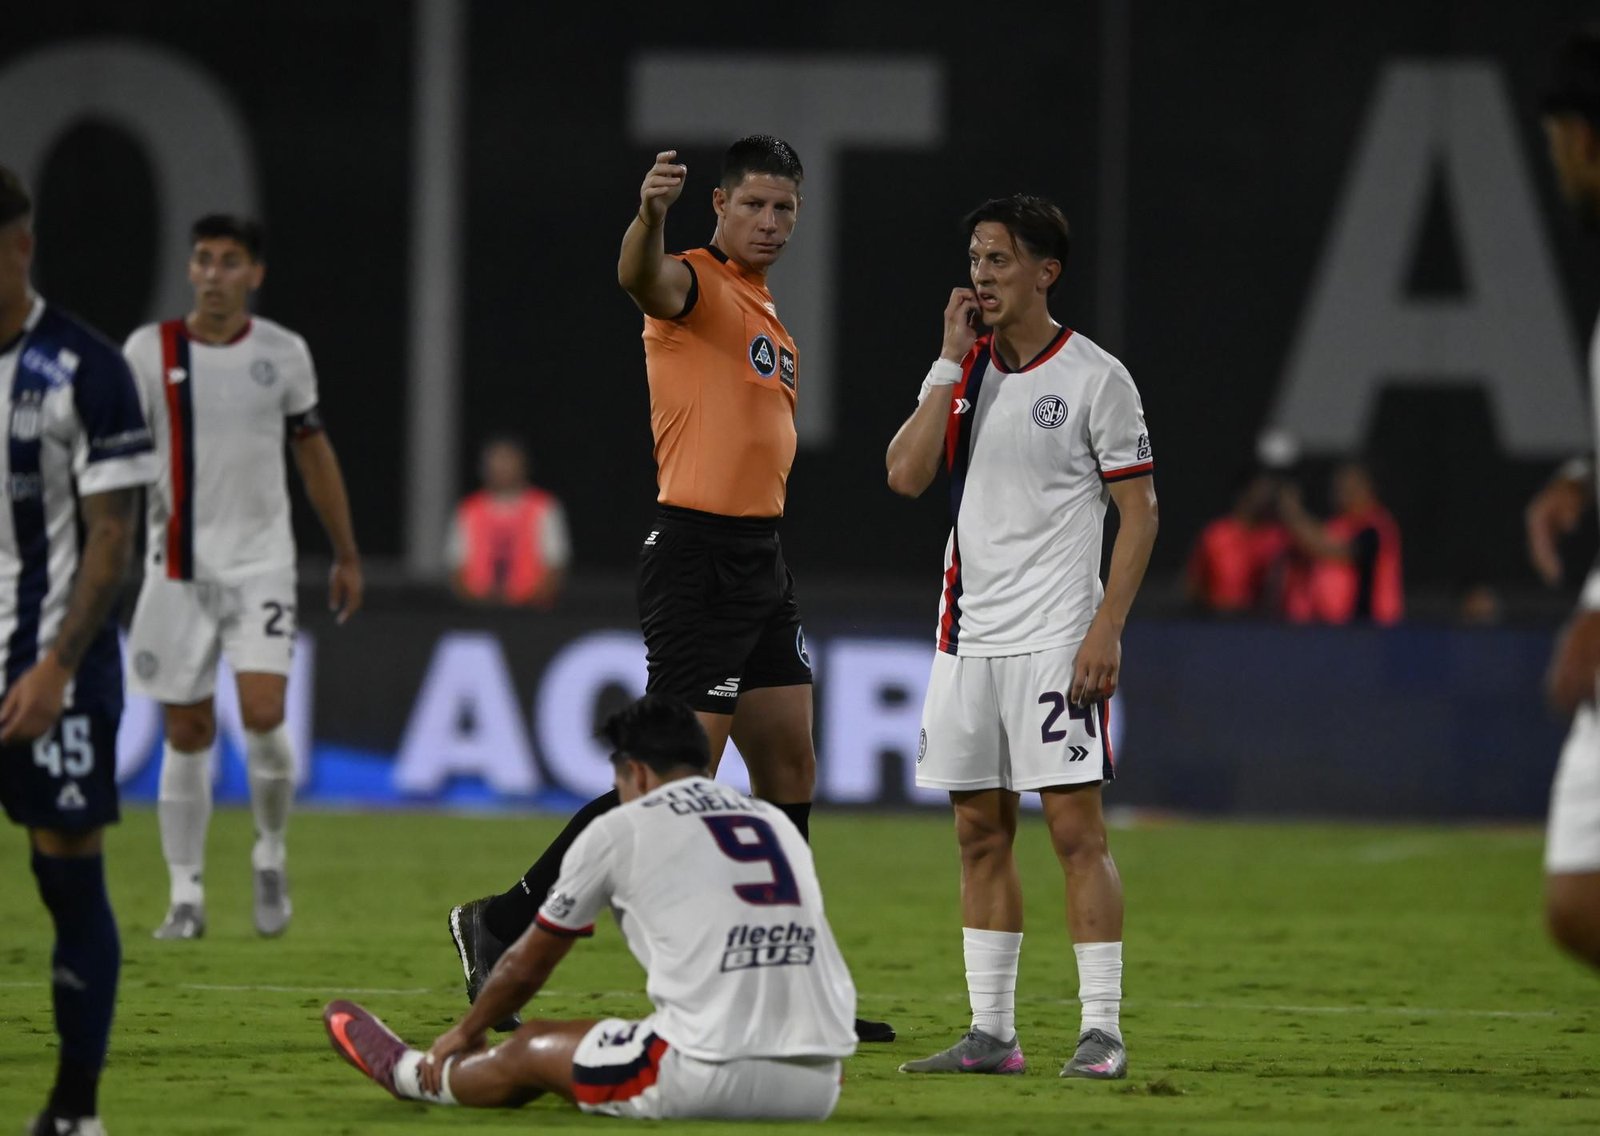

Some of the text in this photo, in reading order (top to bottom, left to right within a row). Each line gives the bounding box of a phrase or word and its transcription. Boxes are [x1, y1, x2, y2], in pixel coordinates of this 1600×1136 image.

[32, 715, 94, 777] 45
[1038, 691, 1097, 743] 24
[701, 814, 802, 907] 9
